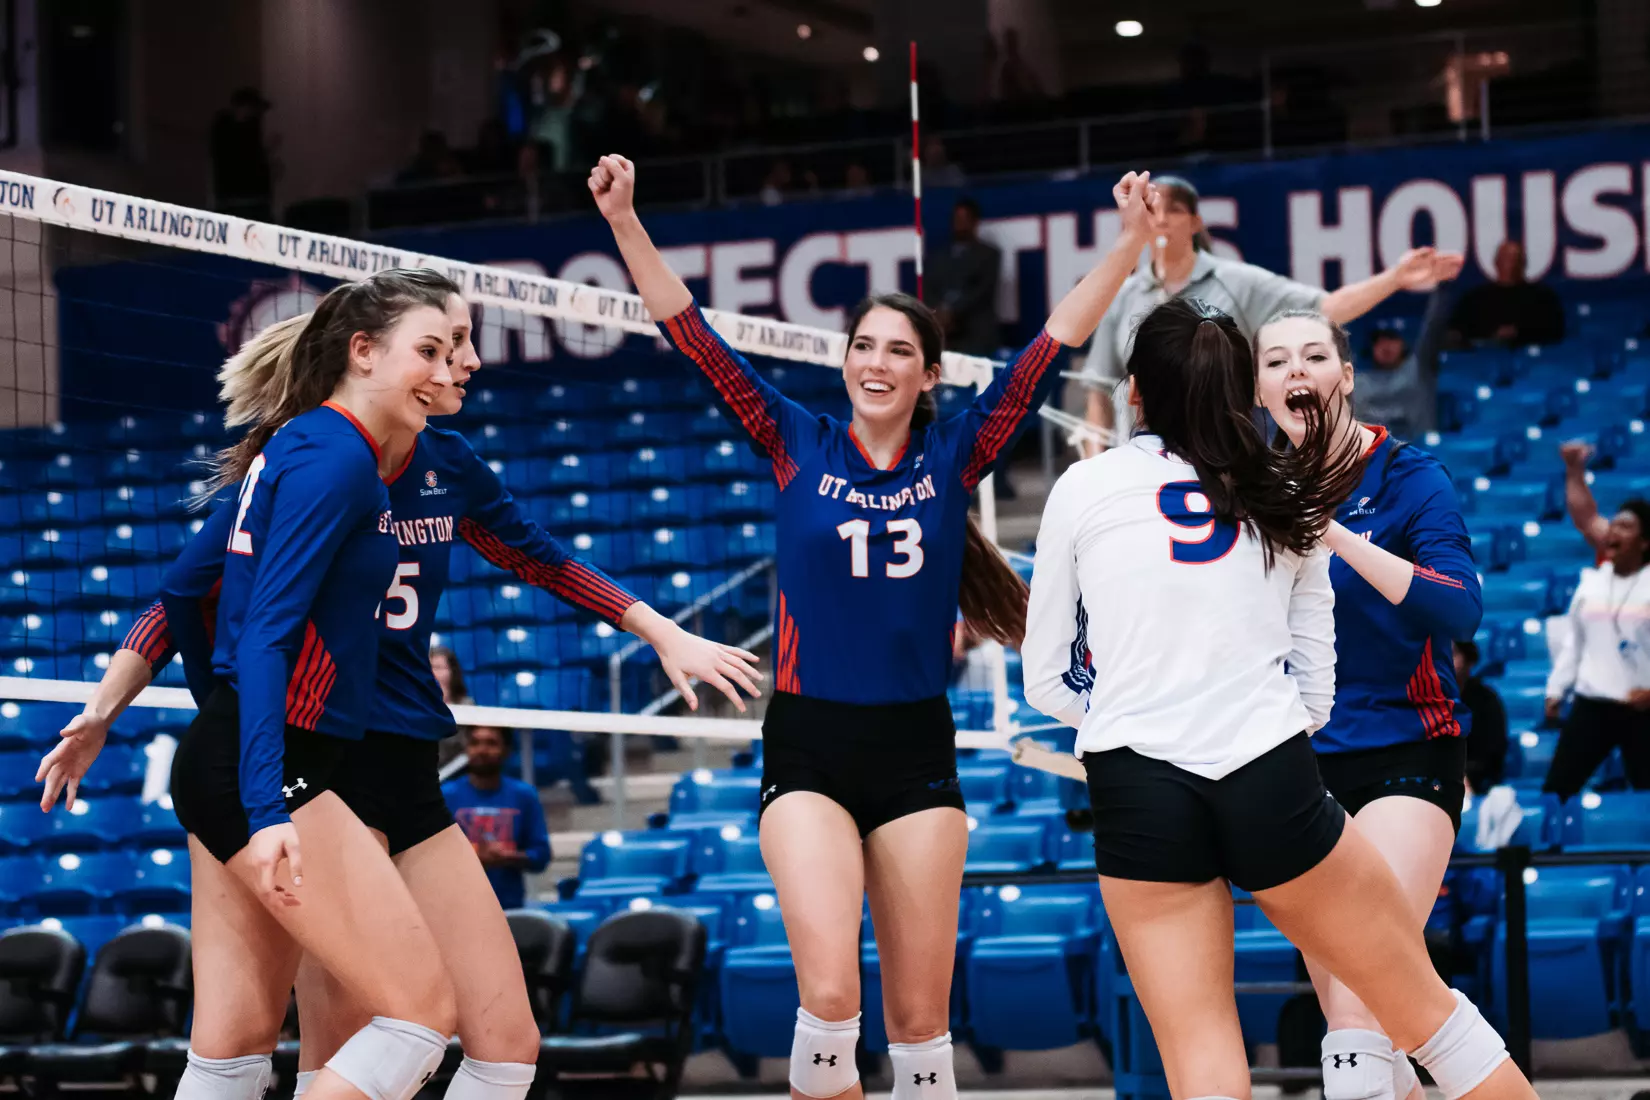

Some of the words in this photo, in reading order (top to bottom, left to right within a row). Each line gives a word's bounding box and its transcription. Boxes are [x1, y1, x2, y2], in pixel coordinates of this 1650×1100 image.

[91, 198, 115, 225] UT
[124, 204, 229, 244] ARLINGTON
[1288, 160, 1650, 294] HOUS
[278, 233, 302, 258] UT
[473, 272, 558, 307] ARLINGTON
[598, 295, 618, 318] UT
[818, 473, 848, 499] UT
[1156, 480, 1241, 565] 9
[836, 517, 925, 579] 13
[375, 561, 421, 631] 5
